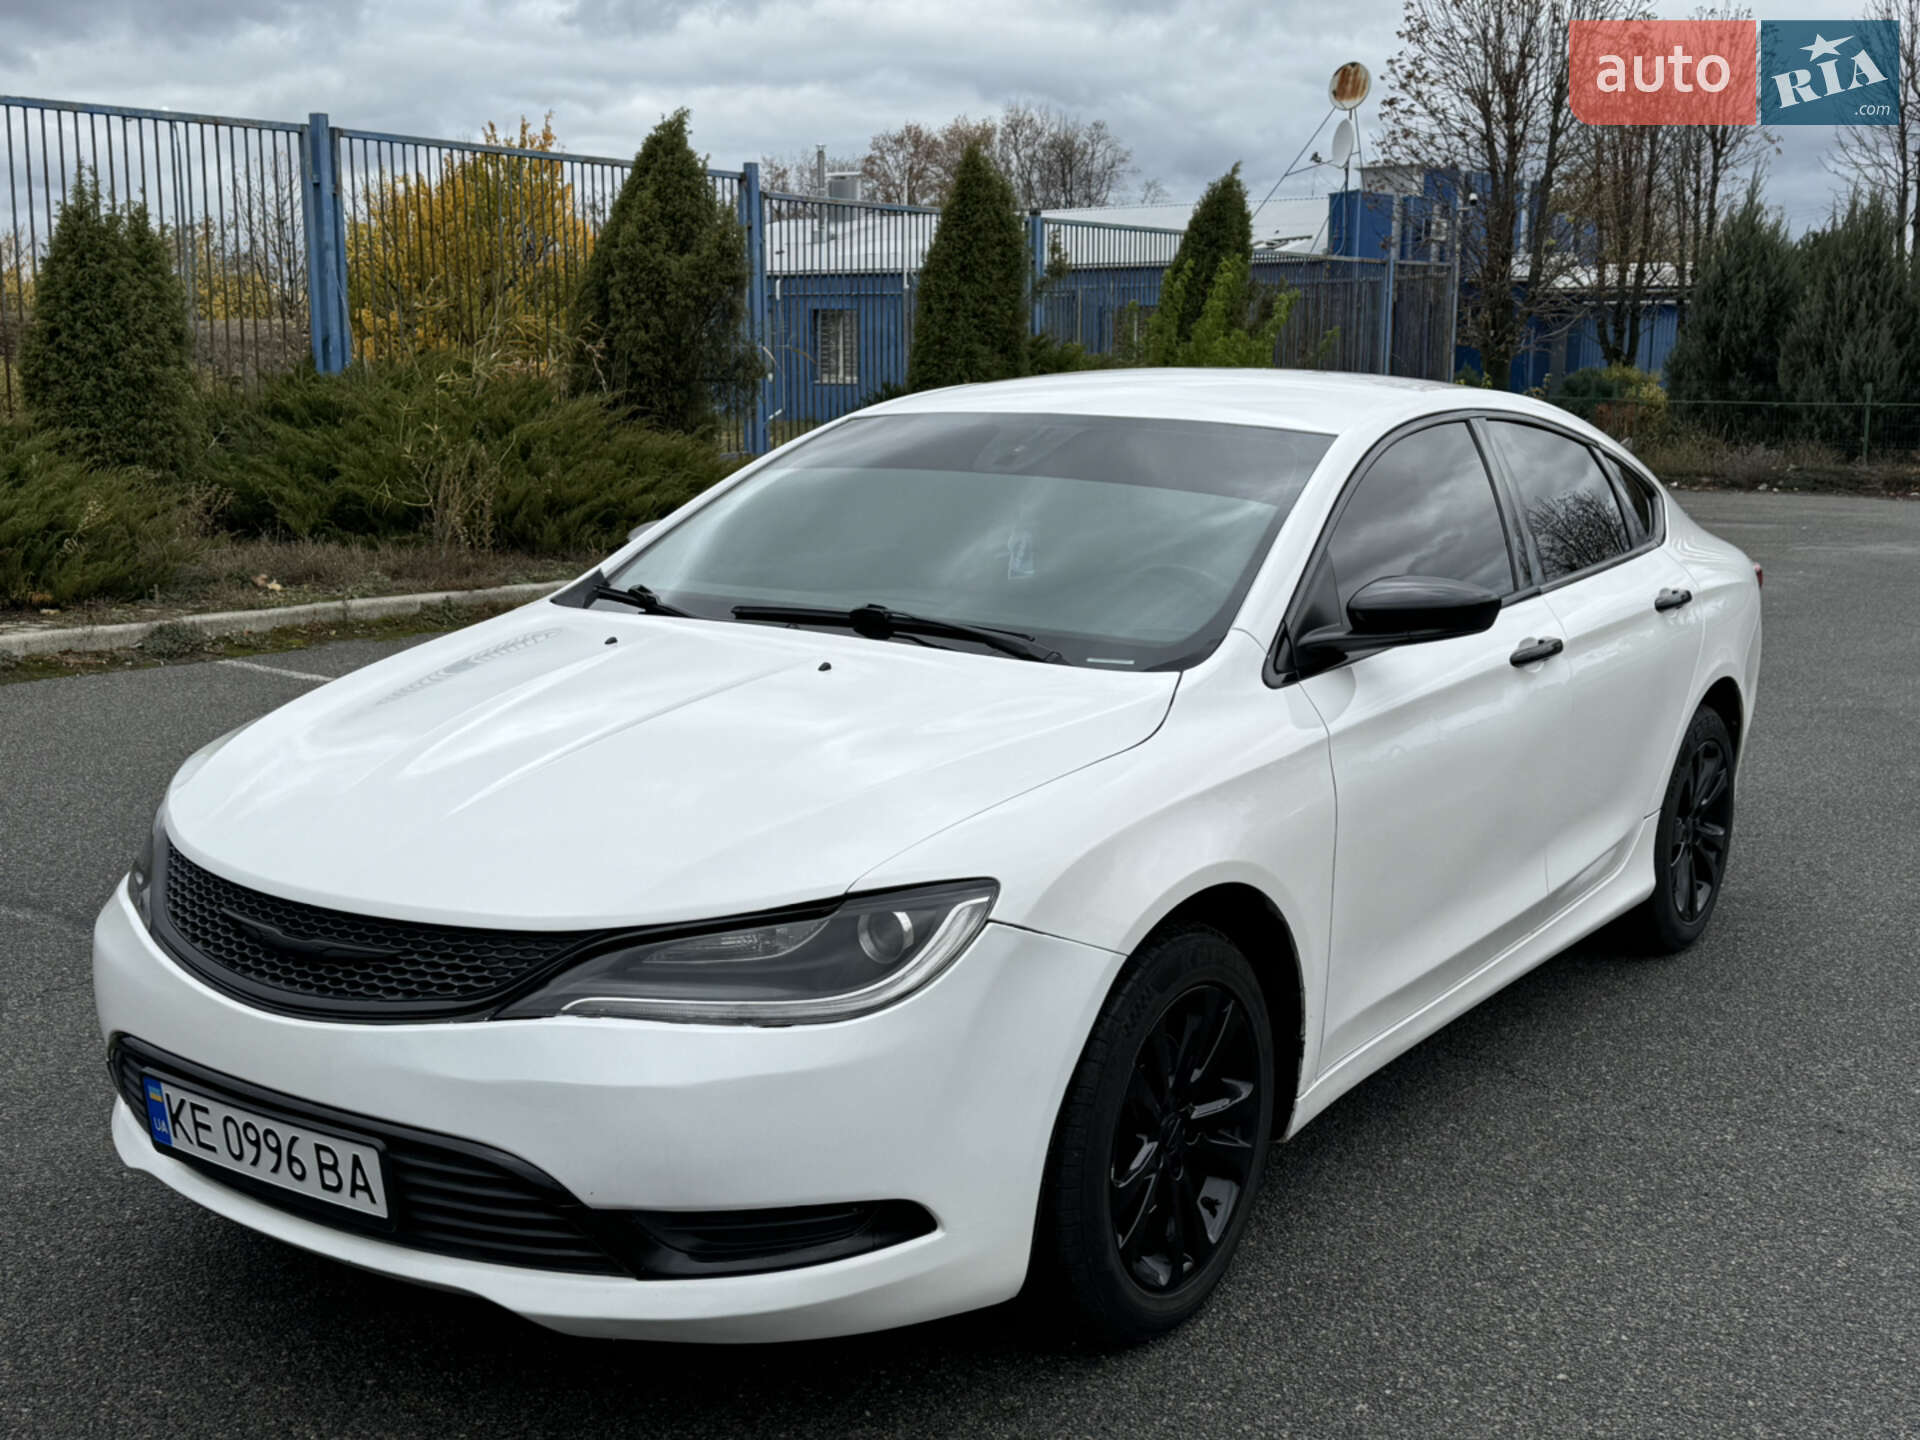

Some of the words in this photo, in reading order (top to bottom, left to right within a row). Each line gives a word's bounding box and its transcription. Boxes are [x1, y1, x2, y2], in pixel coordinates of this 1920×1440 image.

[153, 1118, 169, 1135] UA
[165, 1093, 217, 1153] KE
[222, 1115, 307, 1182] 0996
[313, 1142, 377, 1204] BA
